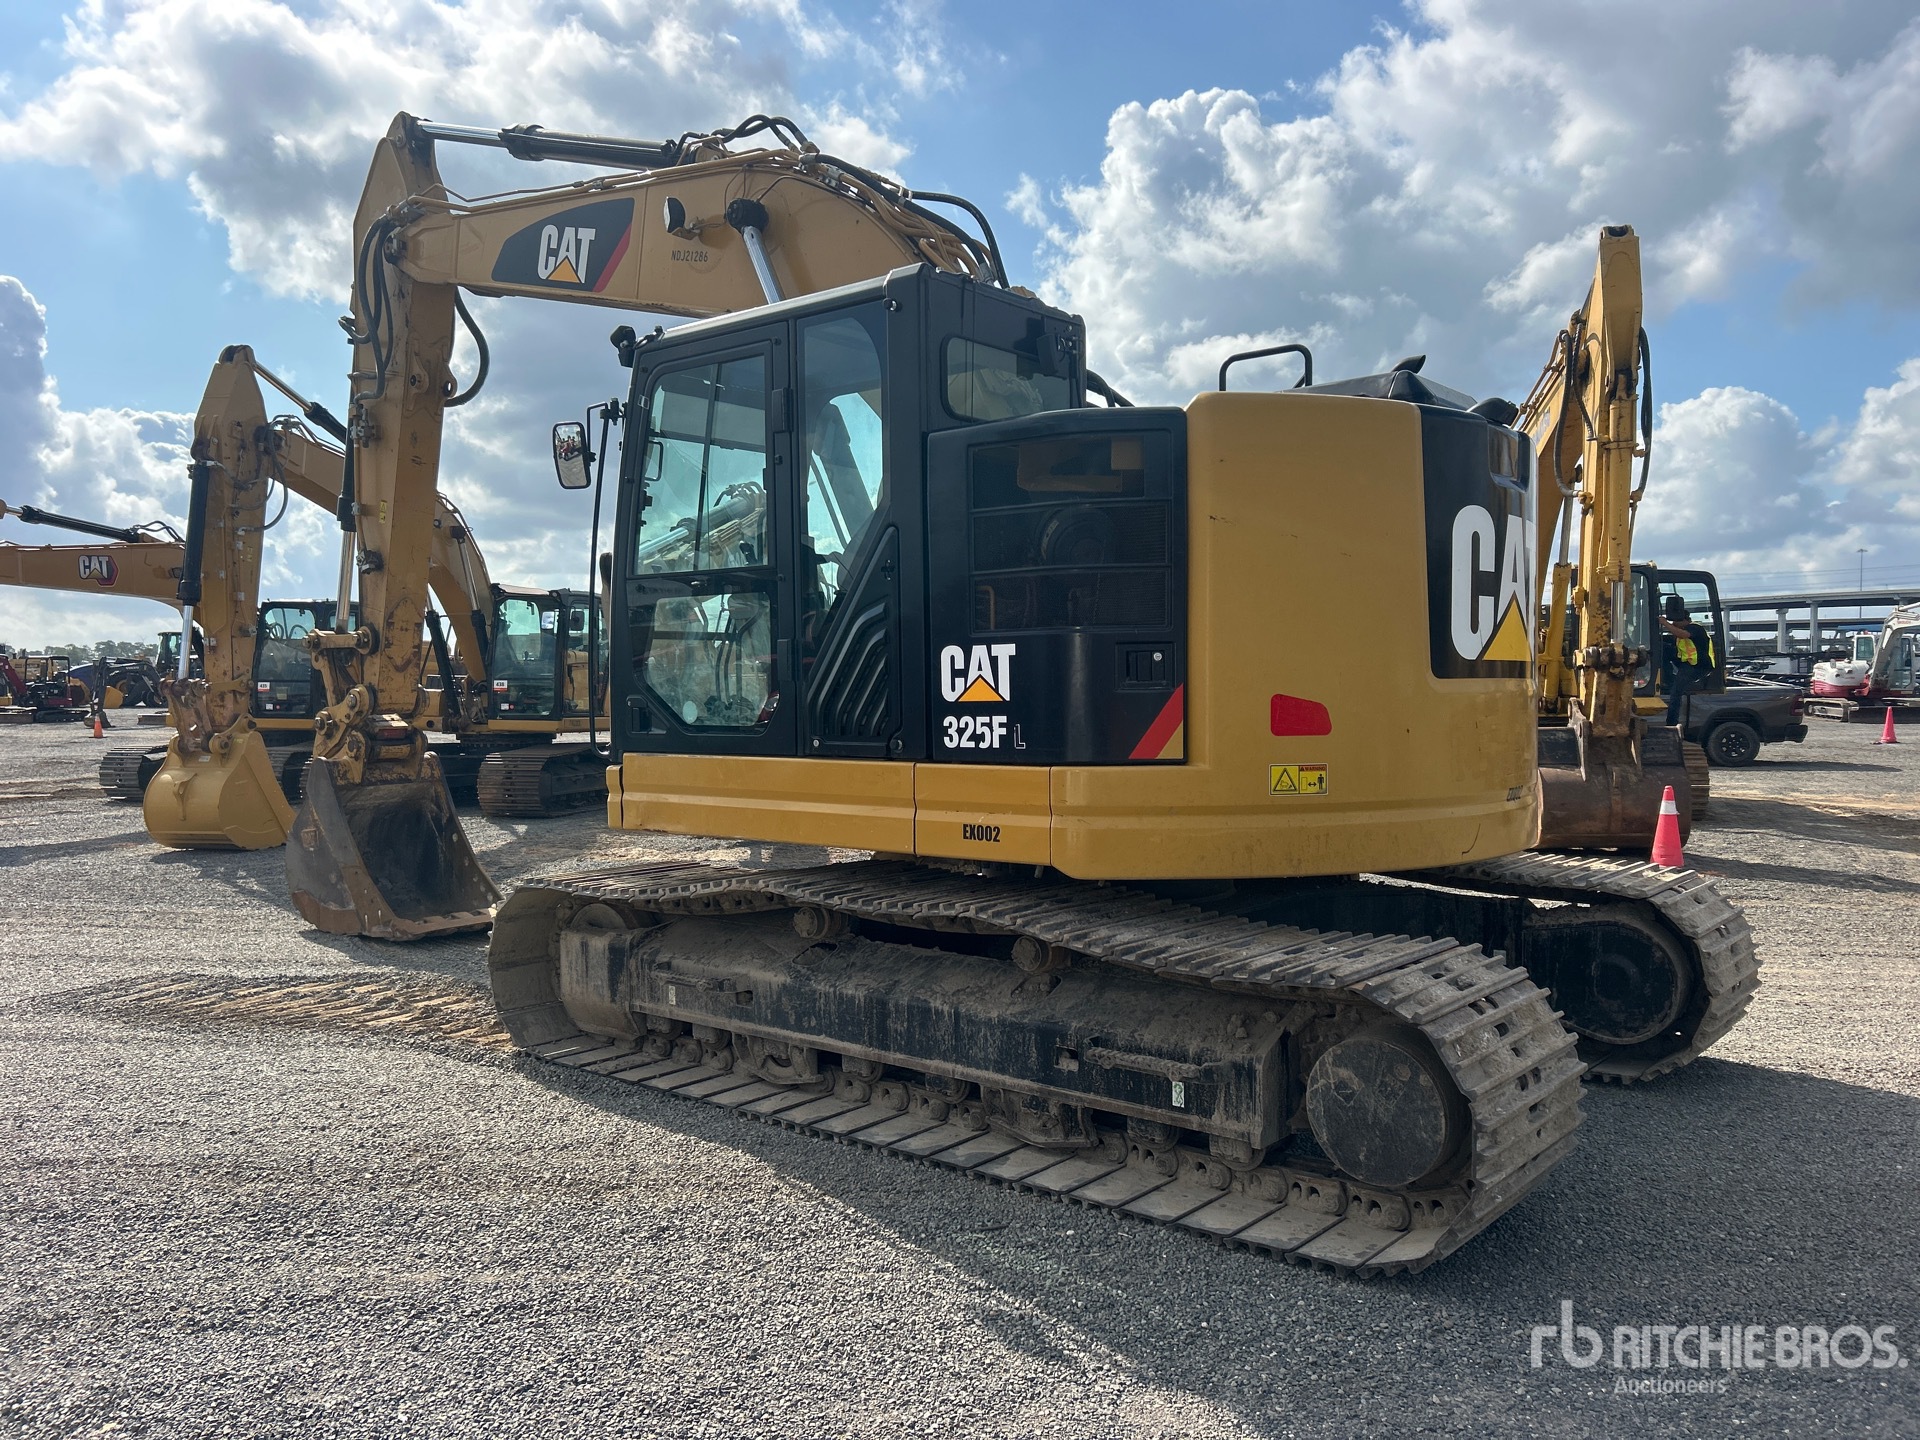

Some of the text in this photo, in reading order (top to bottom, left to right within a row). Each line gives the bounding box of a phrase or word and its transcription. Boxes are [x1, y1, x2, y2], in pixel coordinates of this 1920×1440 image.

[538, 224, 596, 284] CAT
[671, 250, 709, 263] NDJ21286
[79, 555, 109, 579] CAT
[1451, 504, 1536, 661] CAT
[940, 643, 1016, 702] CAT
[943, 715, 1026, 749] 325F L
[962, 823, 1001, 842] EX002
